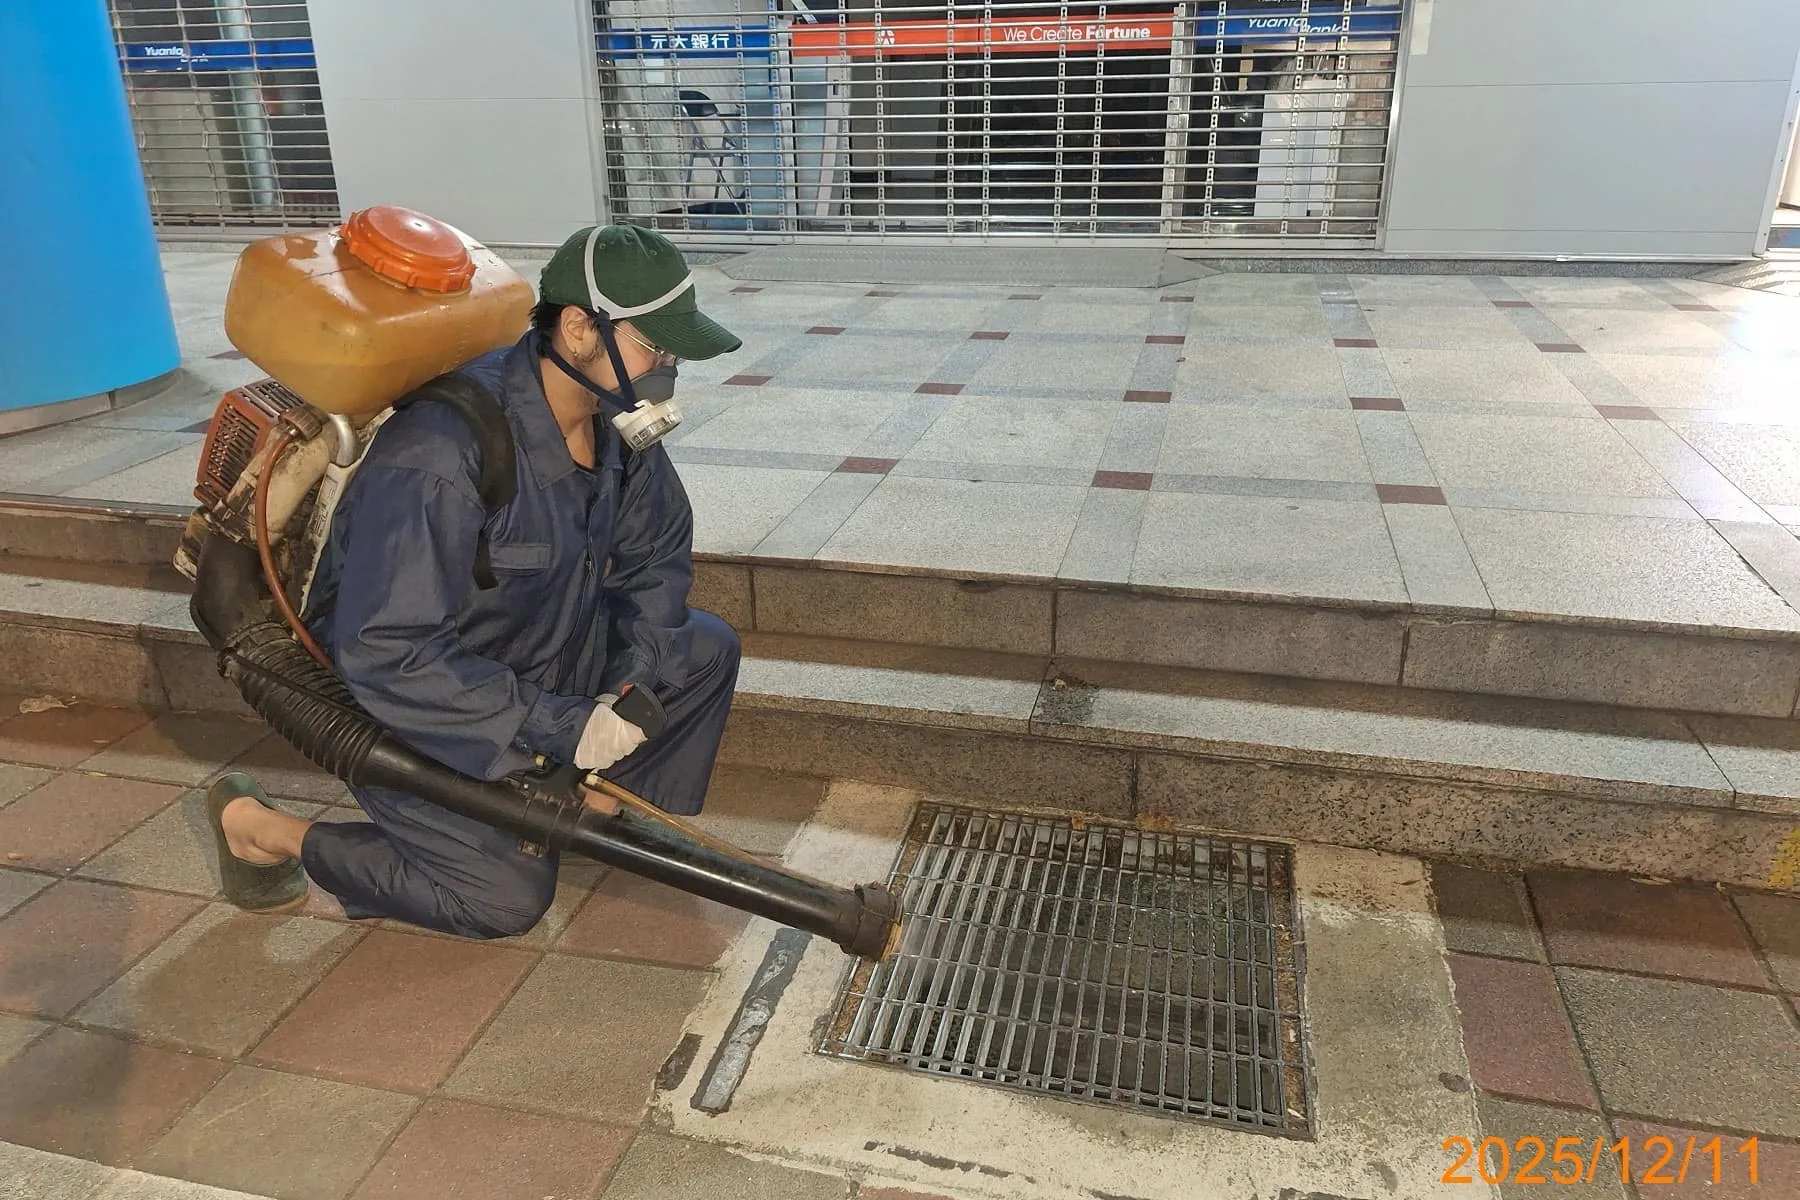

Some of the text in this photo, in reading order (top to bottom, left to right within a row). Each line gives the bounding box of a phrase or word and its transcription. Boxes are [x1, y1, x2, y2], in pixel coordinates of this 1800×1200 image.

[1003, 27, 1027, 41] We
[1304, 23, 1343, 34] ank
[650, 33, 730, 49] 元大銀行
